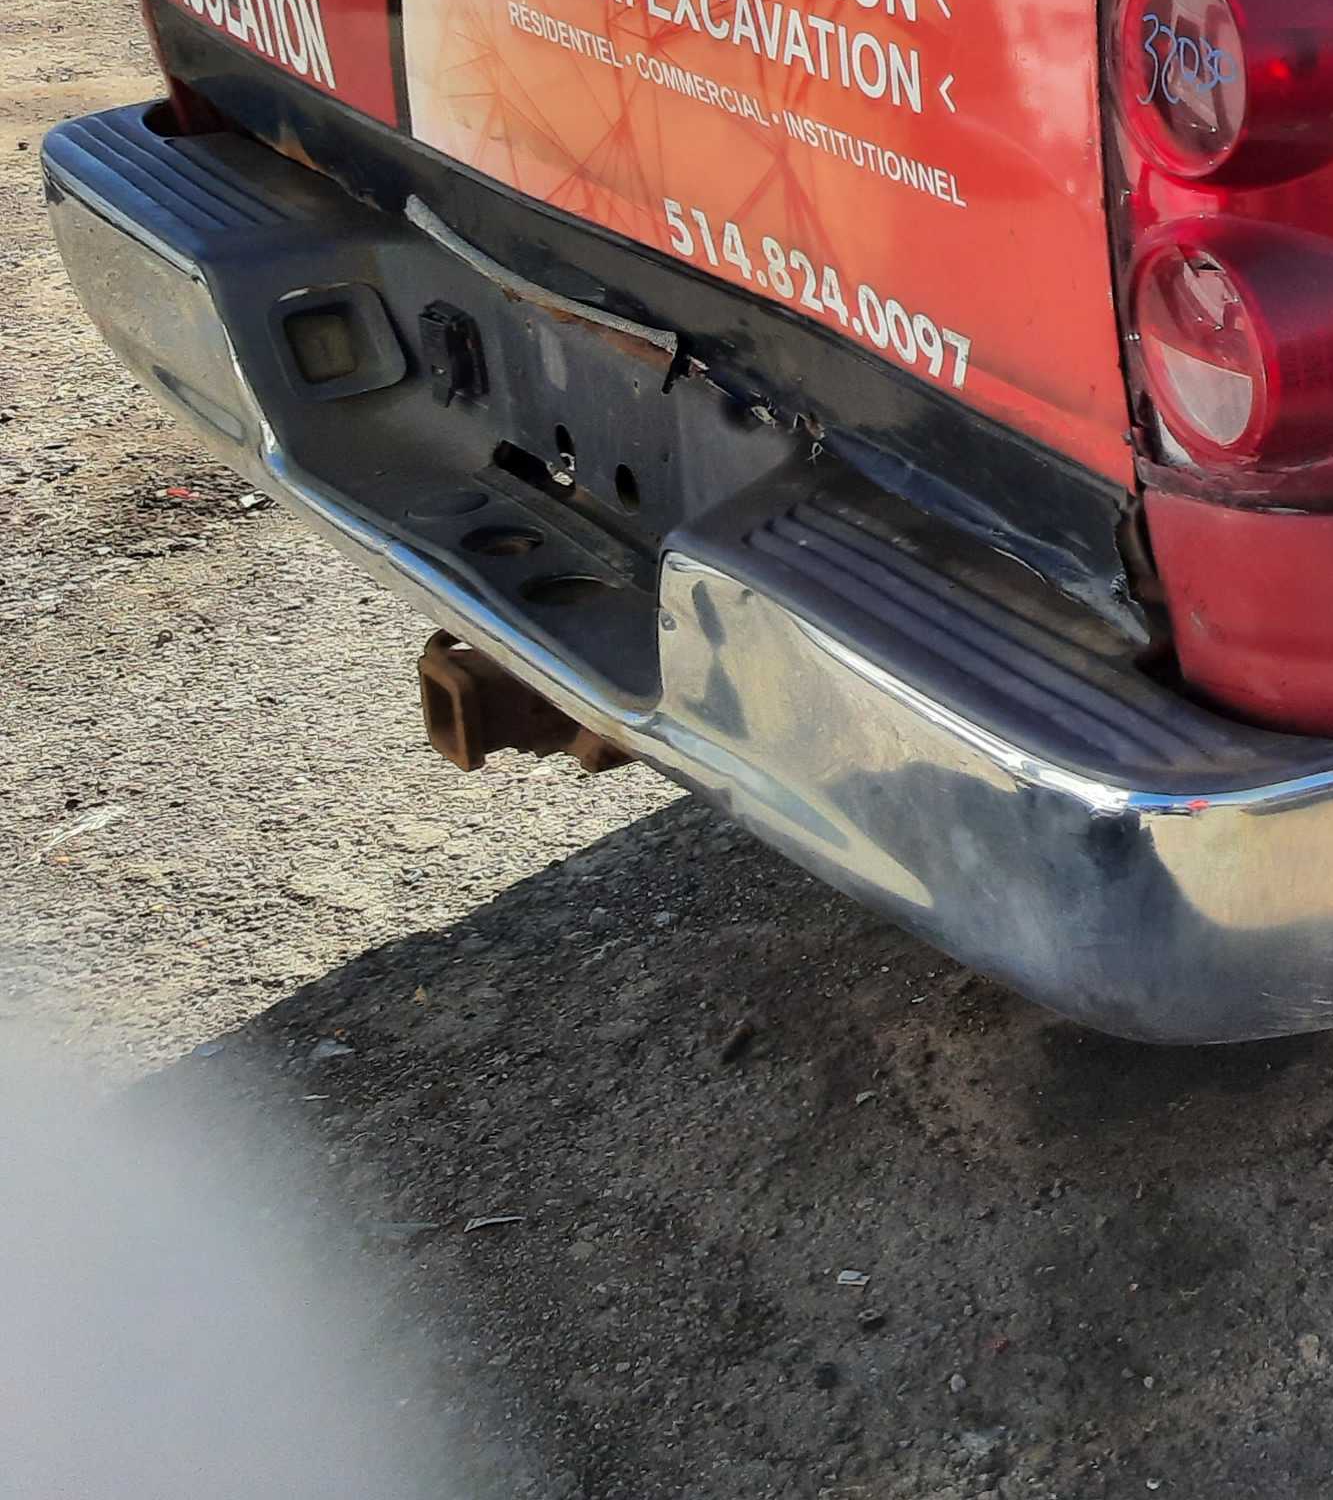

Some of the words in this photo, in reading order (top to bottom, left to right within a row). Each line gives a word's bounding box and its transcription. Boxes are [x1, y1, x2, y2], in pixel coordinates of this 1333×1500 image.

[507, 0, 624, 70] RÉSIDENTIEL
[635, 50, 771, 129] COMMERCIAL
[783, 109, 968, 208] INSTITUTIONNEL
[663, 196, 974, 389] 514.824.0097
